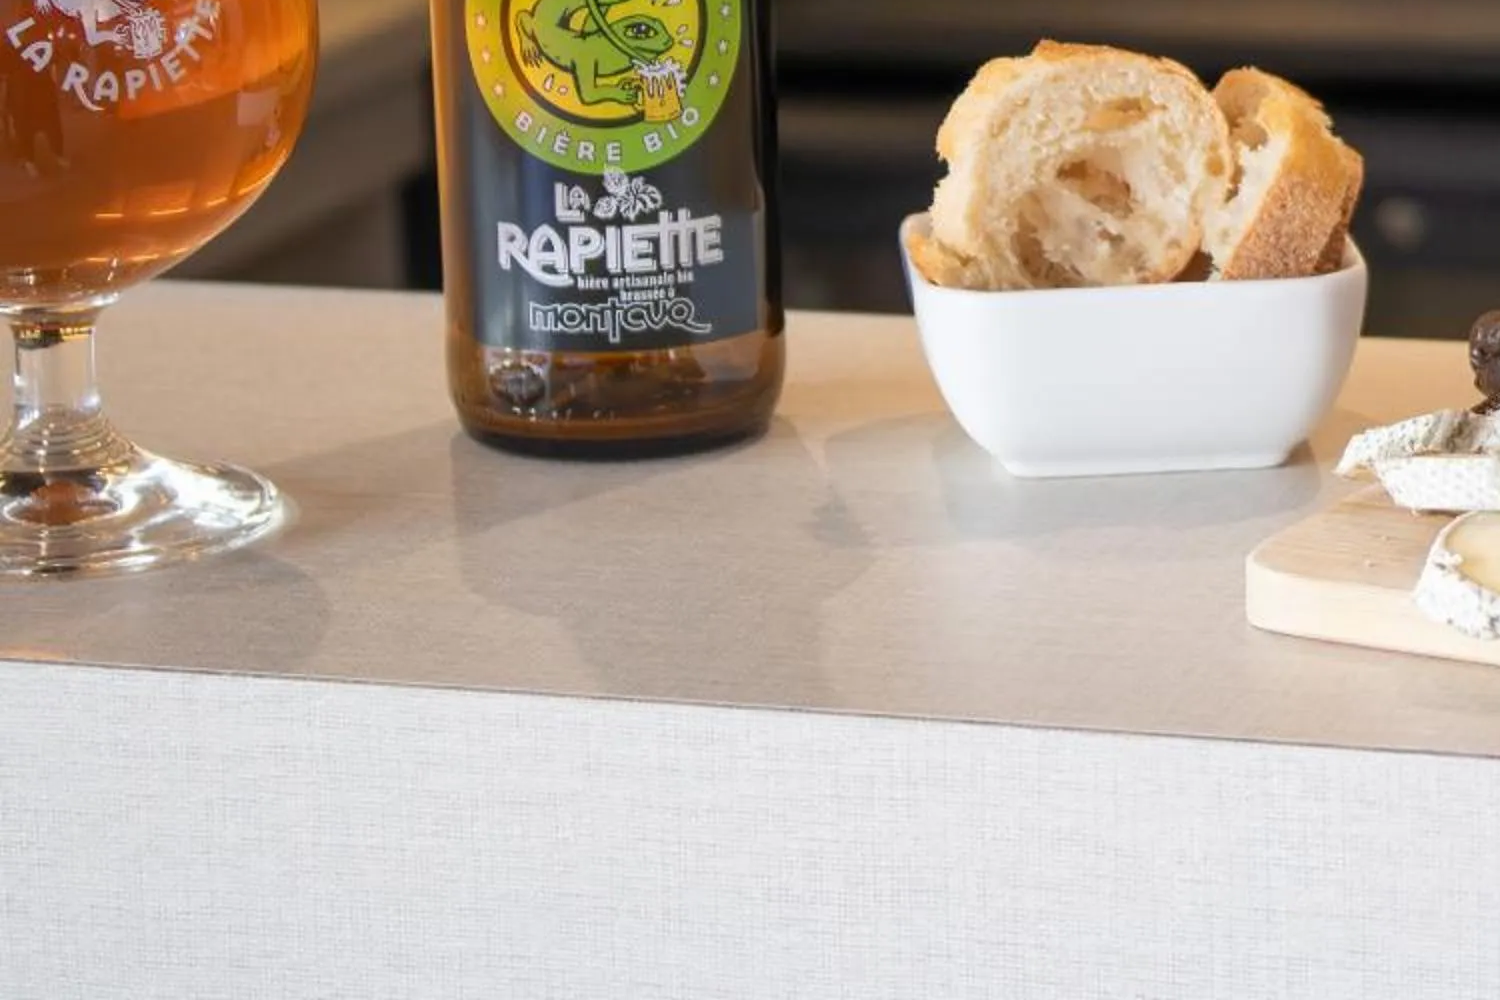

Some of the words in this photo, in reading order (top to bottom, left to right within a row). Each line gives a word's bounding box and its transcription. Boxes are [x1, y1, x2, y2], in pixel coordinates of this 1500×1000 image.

[6, 16, 54, 72] LA
[514, 110, 623, 162] BIÈRE
[643, 107, 699, 154] BIO
[554, 182, 590, 223] LA
